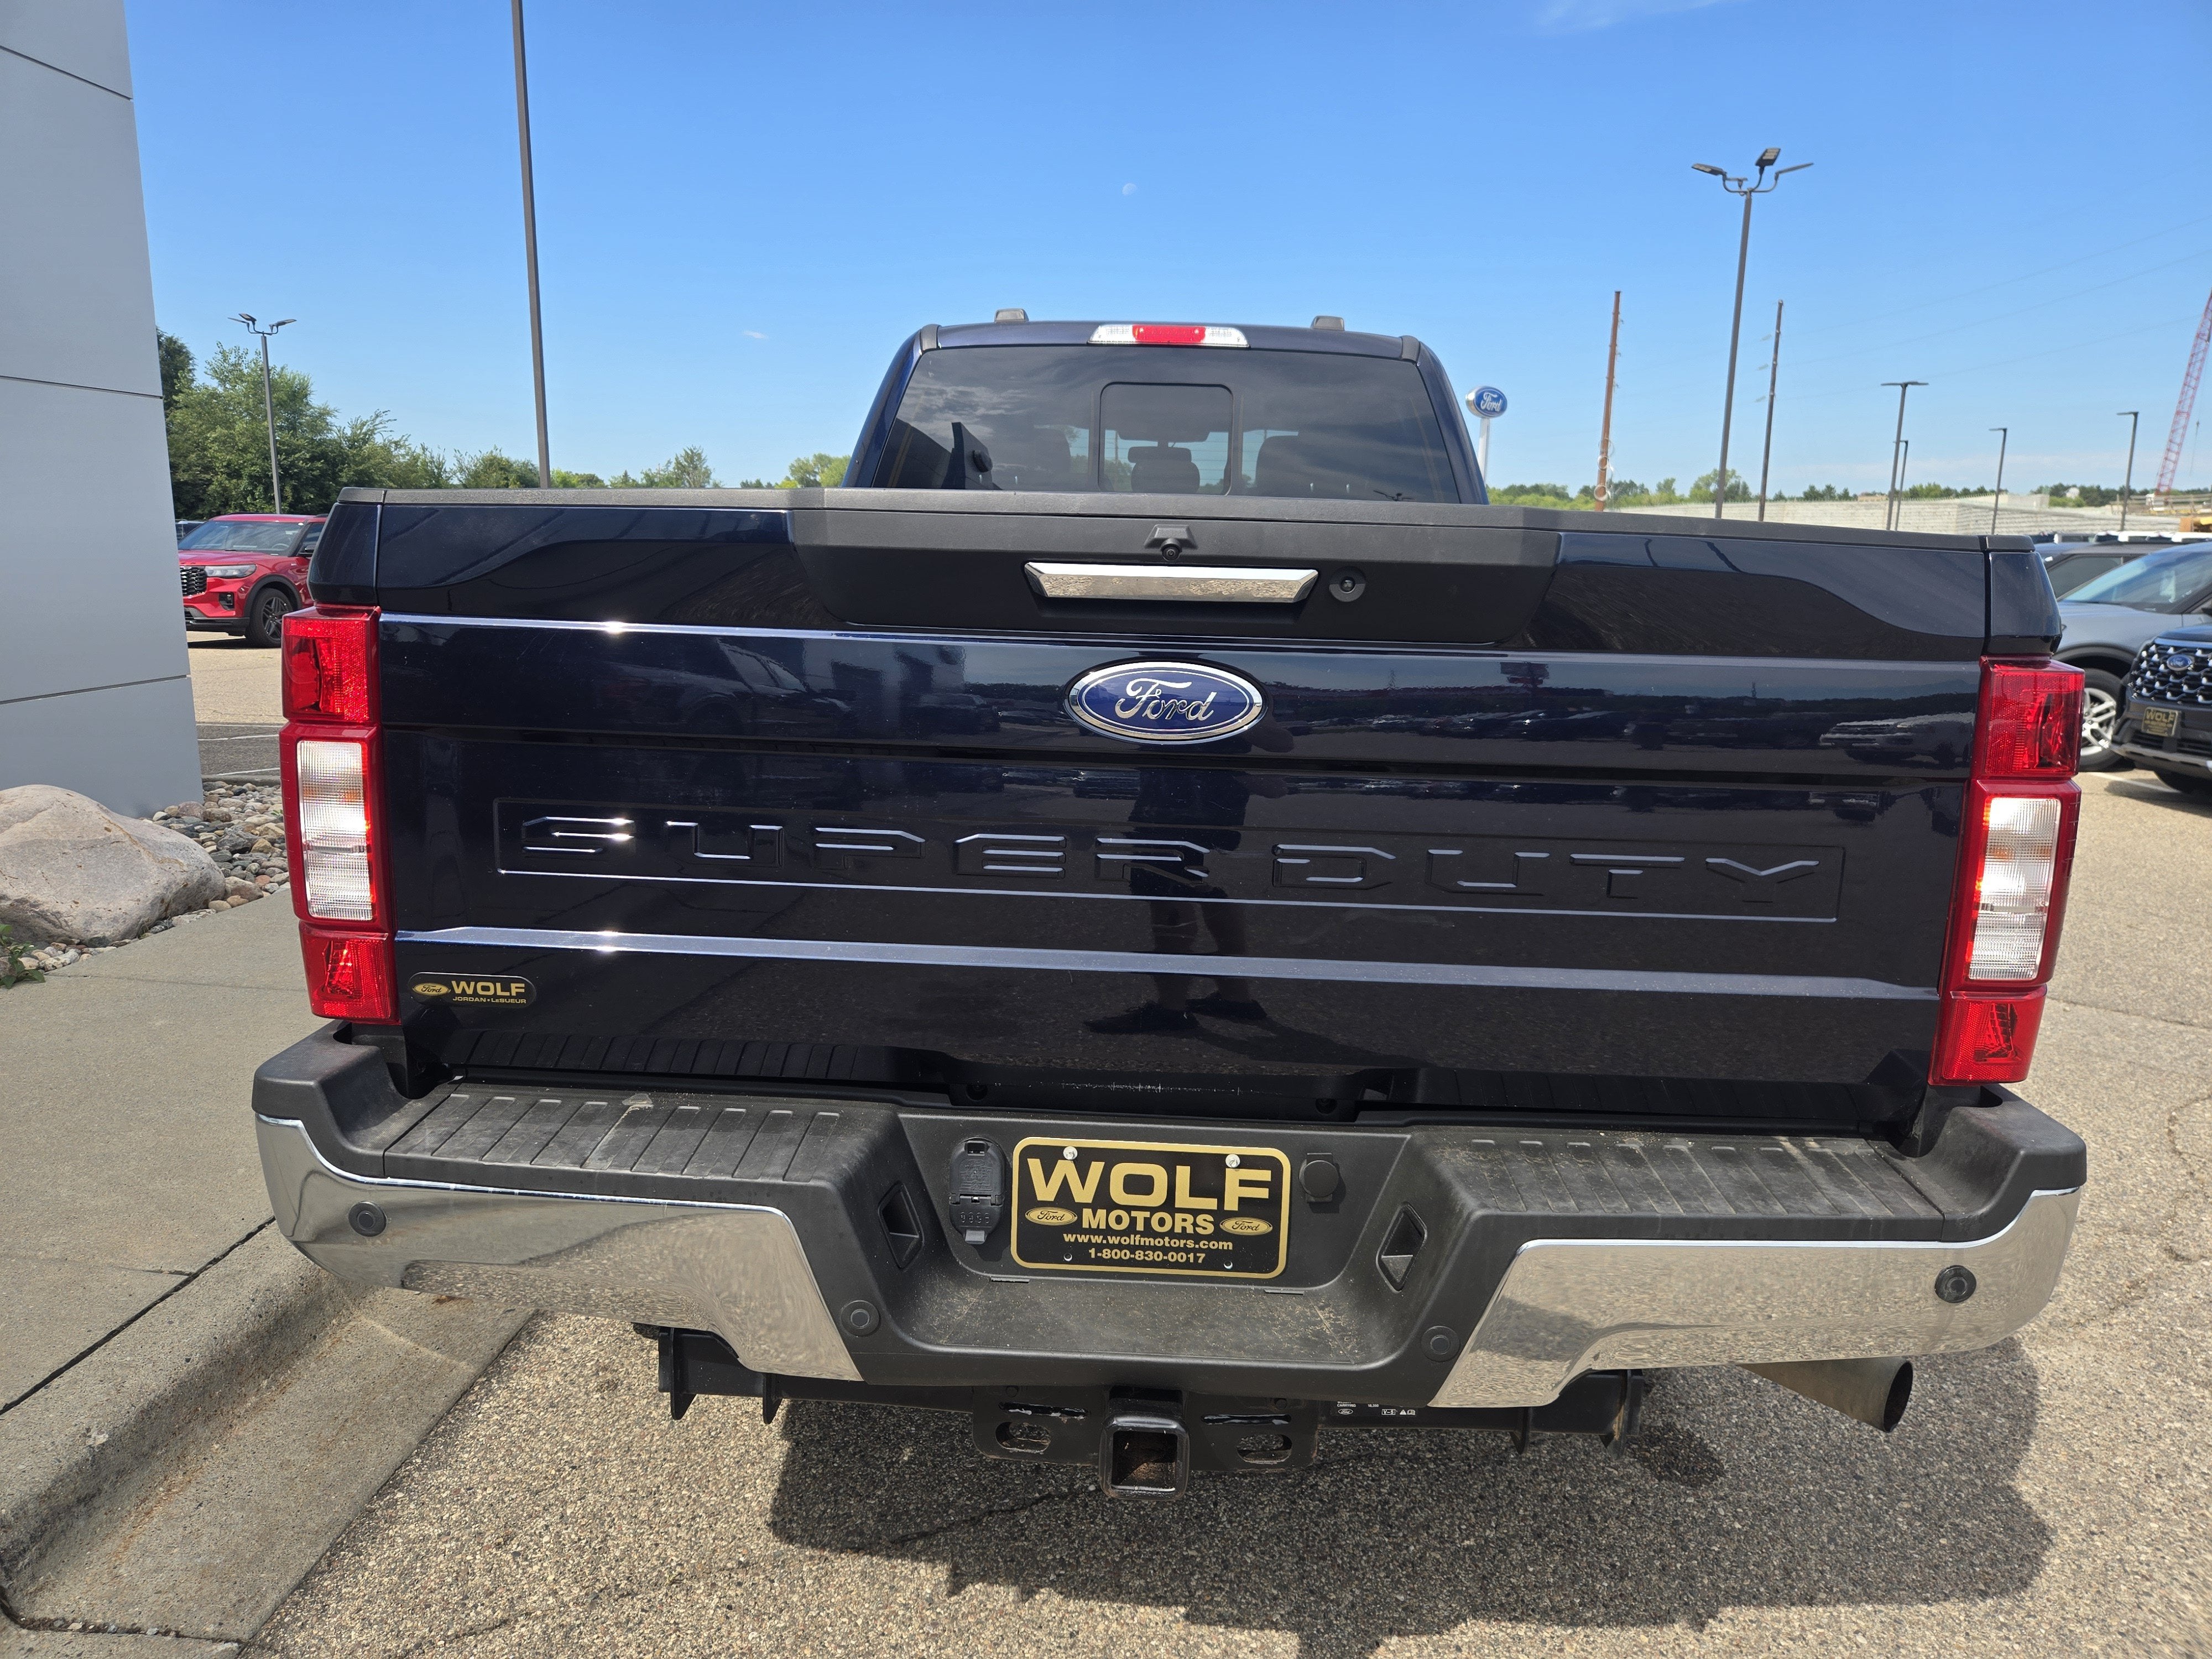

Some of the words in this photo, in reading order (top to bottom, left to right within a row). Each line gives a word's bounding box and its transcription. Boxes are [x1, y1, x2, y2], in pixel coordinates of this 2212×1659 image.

[1480, 392, 1503, 412] Ford
[1115, 677, 1217, 722] Ford
[2146, 710, 2175, 723] WOLF
[521, 816, 1211, 885] SUPER
[1272, 843, 1820, 905] DUTY
[421, 984, 442, 993] Ford
[451, 980, 525, 996] WOLF
[1027, 1157, 1271, 1212] WOLF
[1037, 1210, 1066, 1222] Ford
[1082, 1208, 1214, 1235] MOTORS
[1232, 1219, 1260, 1232] Ford
[1063, 1233, 1233, 1250] www.wolfmotors.com
[1088, 1248, 1206, 1264] 1-800-830-0017
